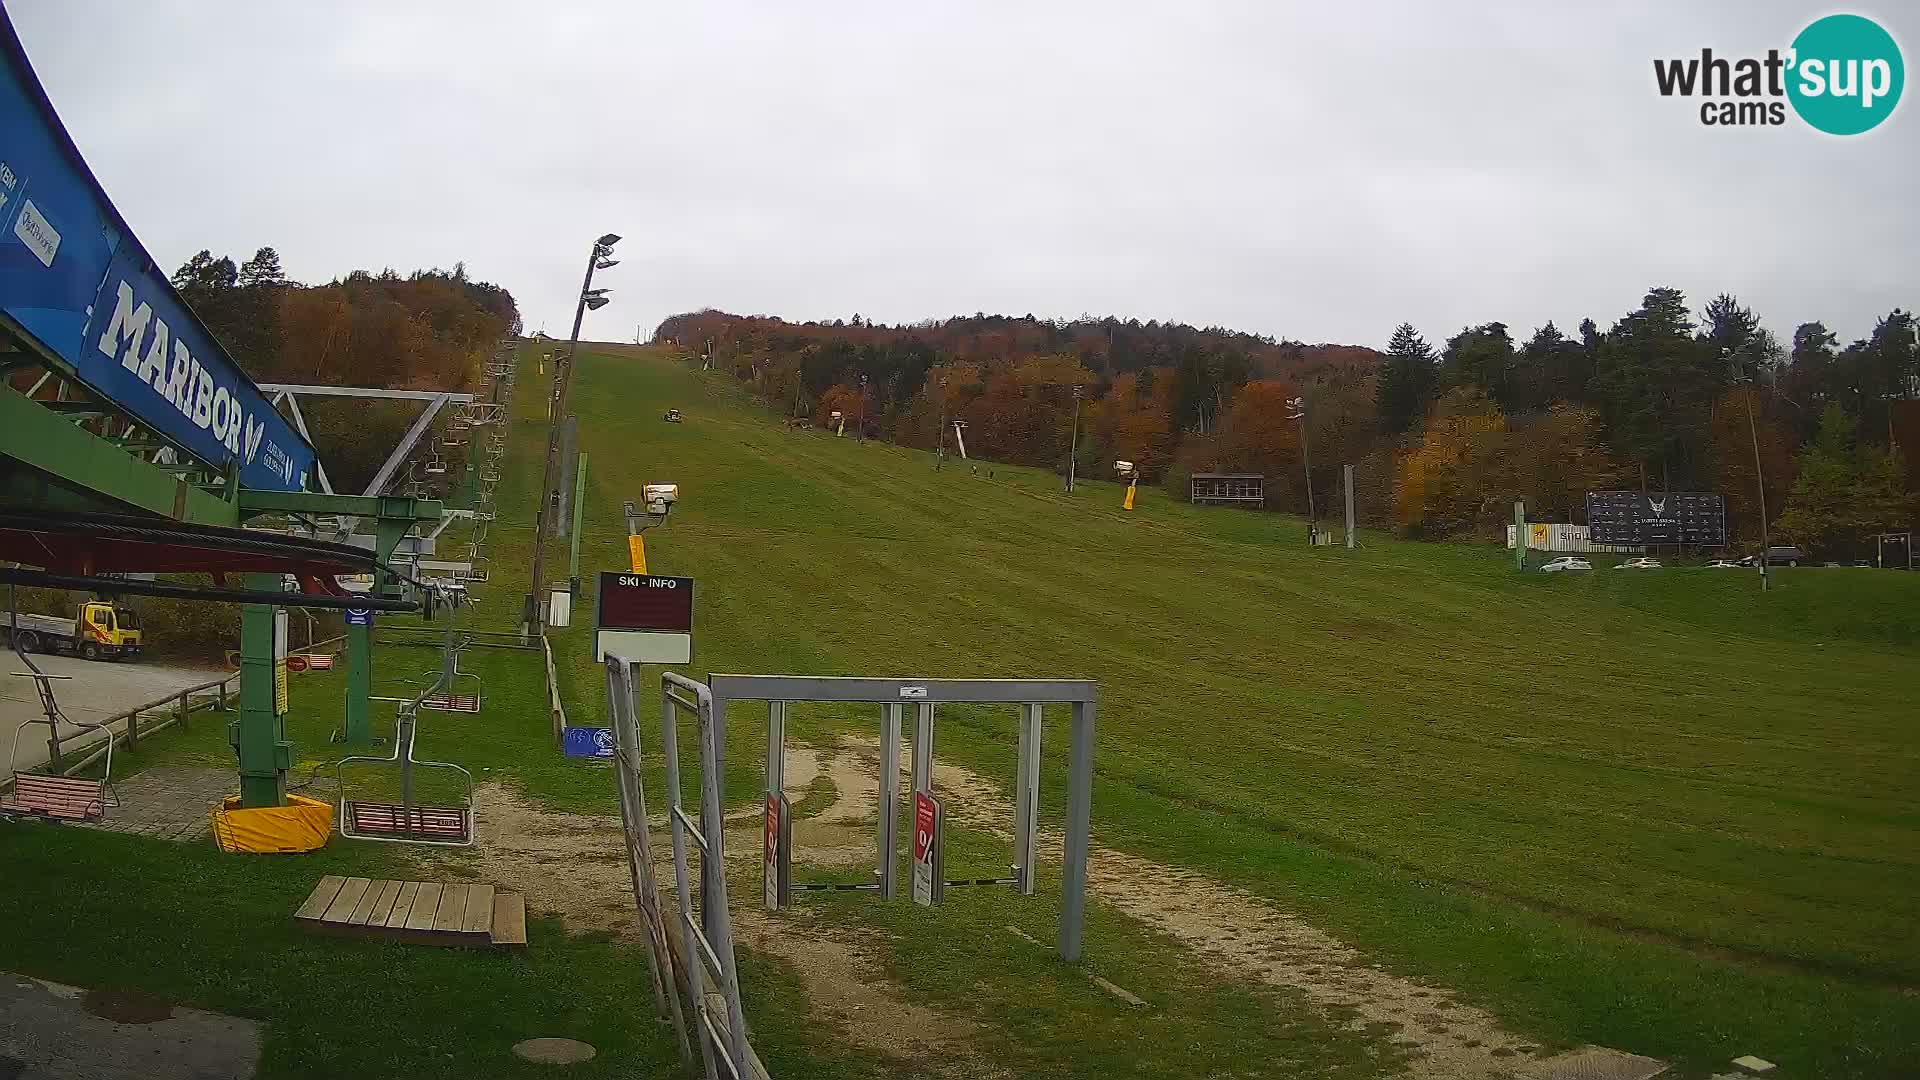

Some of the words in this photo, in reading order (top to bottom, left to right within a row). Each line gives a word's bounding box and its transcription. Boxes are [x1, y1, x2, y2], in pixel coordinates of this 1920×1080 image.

[98, 279, 242, 455] MARIBOR
[619, 576, 638, 587] SKI
[649, 578, 676, 588] INFO
